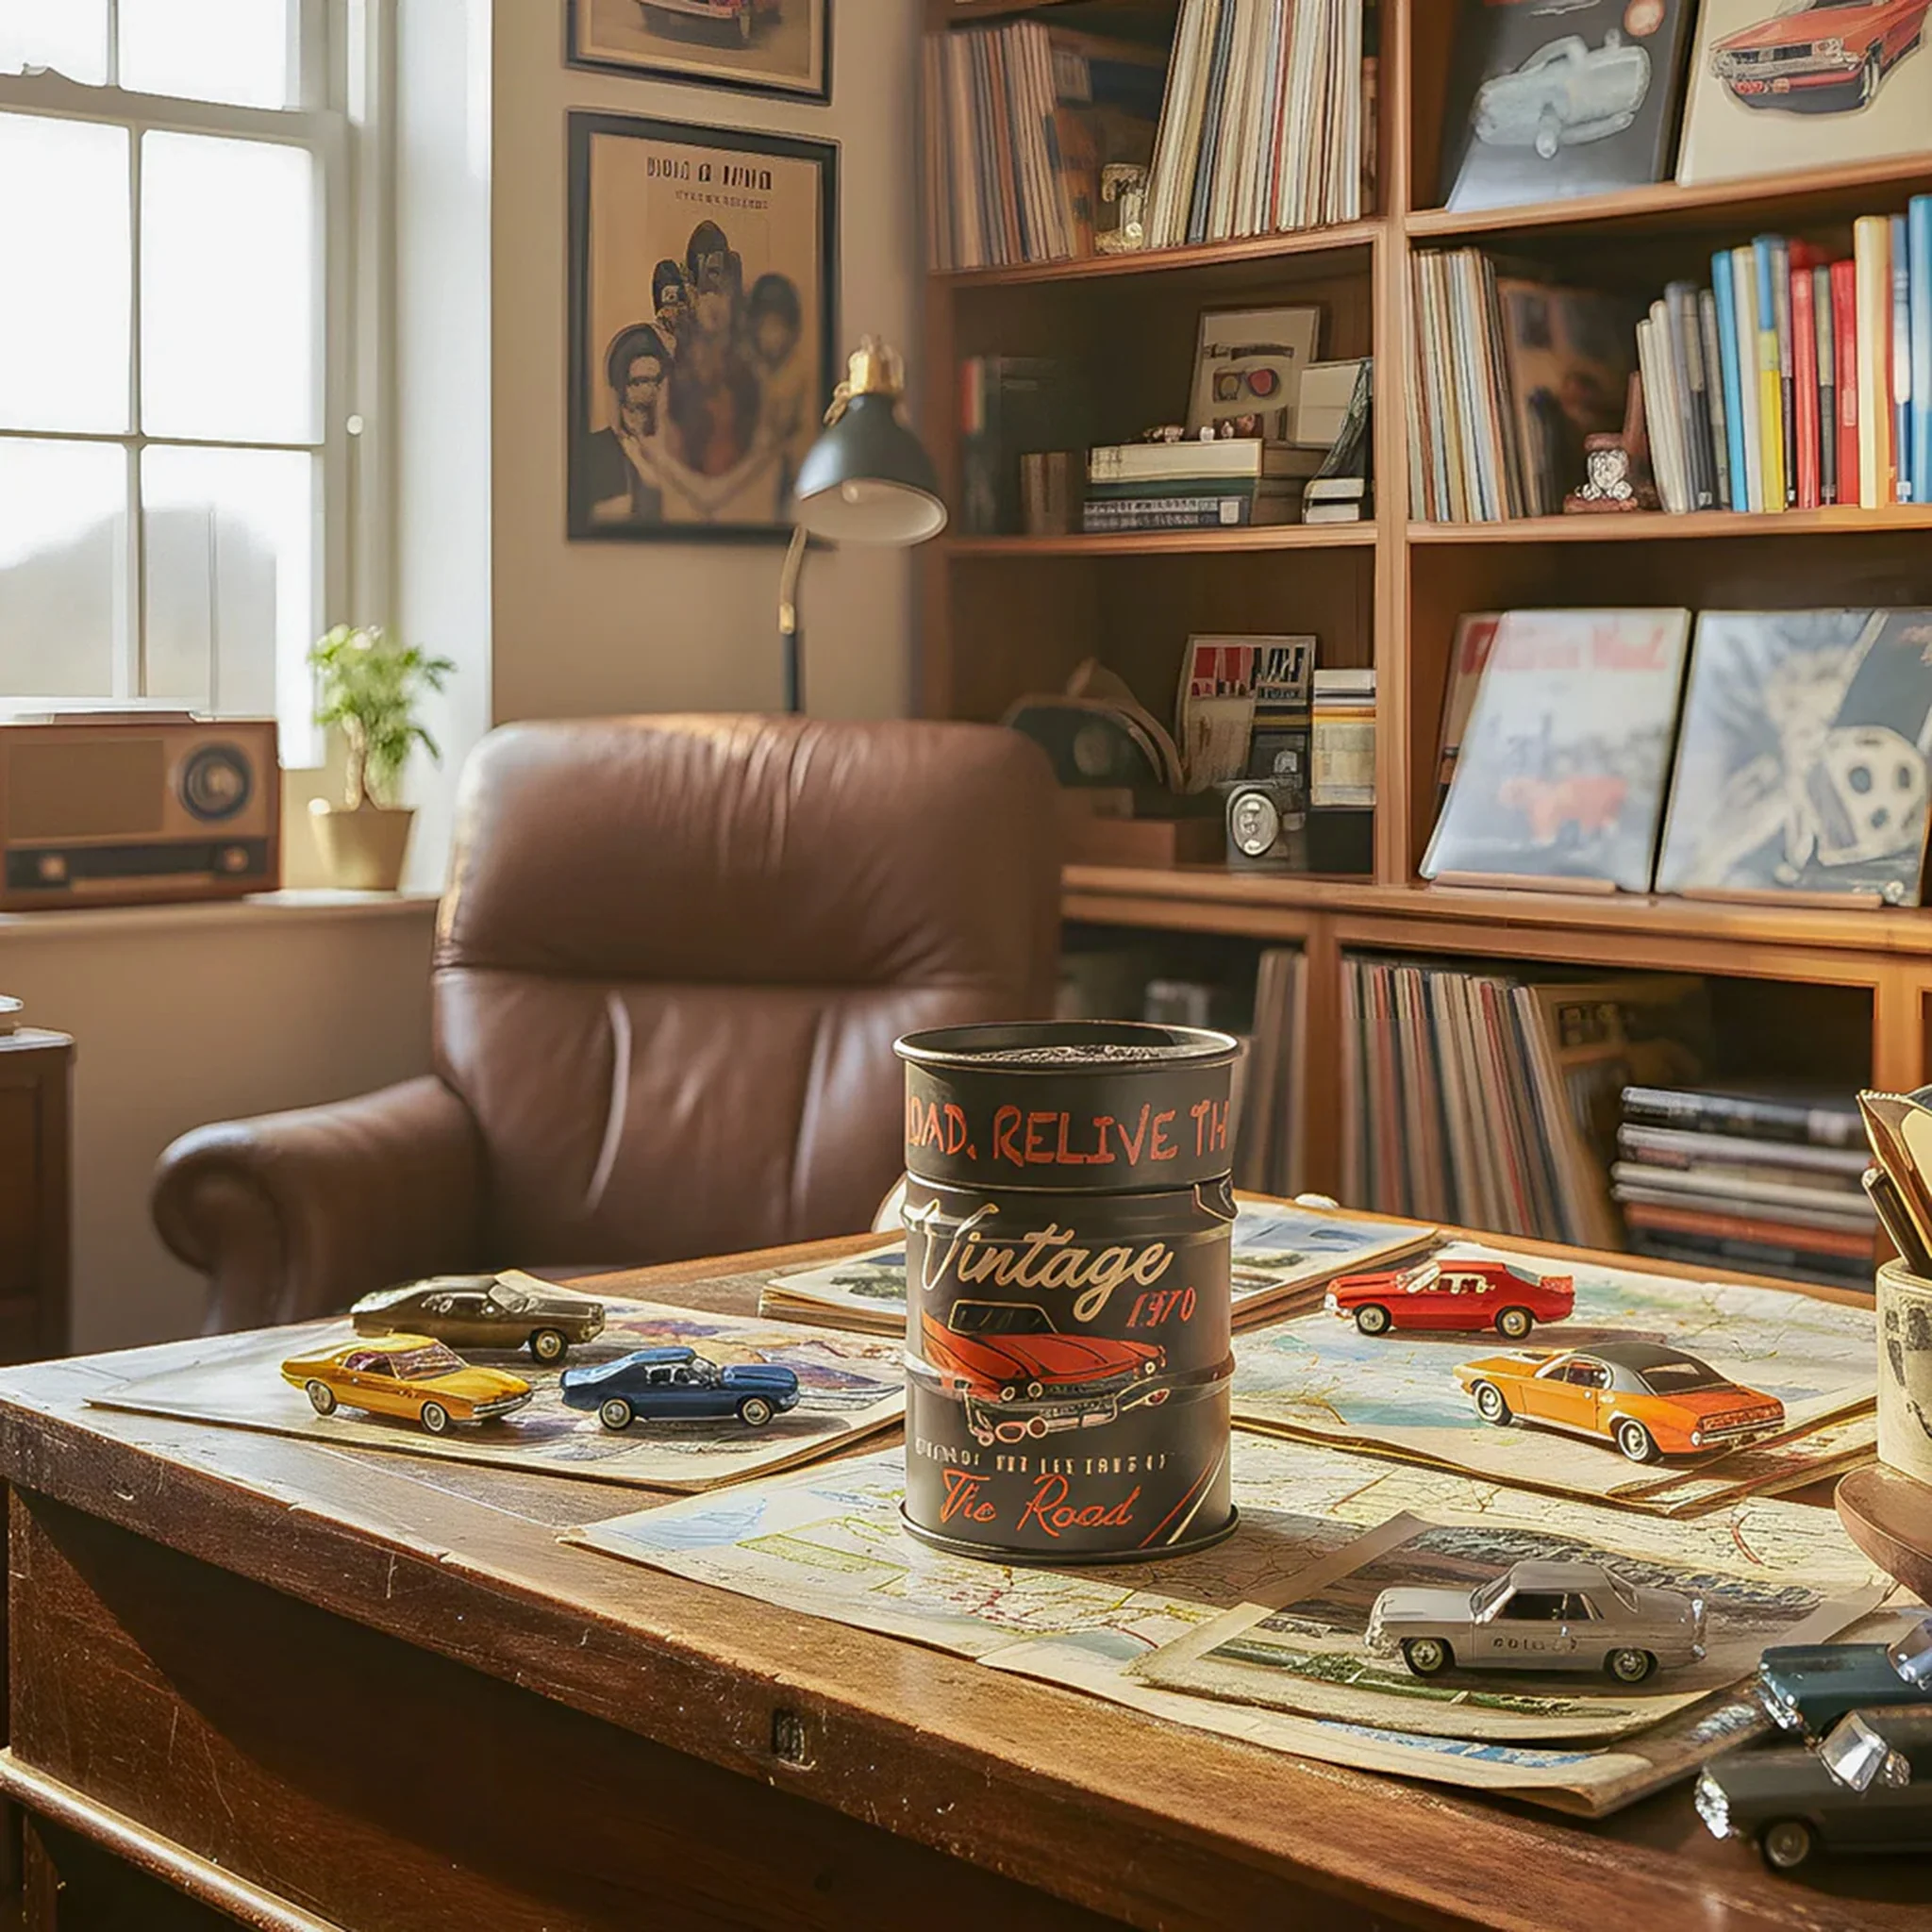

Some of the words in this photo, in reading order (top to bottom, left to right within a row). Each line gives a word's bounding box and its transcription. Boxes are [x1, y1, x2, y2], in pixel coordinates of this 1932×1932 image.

[993, 1104, 1178, 1167] RELIVE
[903, 1198, 1174, 1323] Vintage
[1126, 1287, 1196, 1328] 1970
[1016, 1473, 1141, 1539] Road
